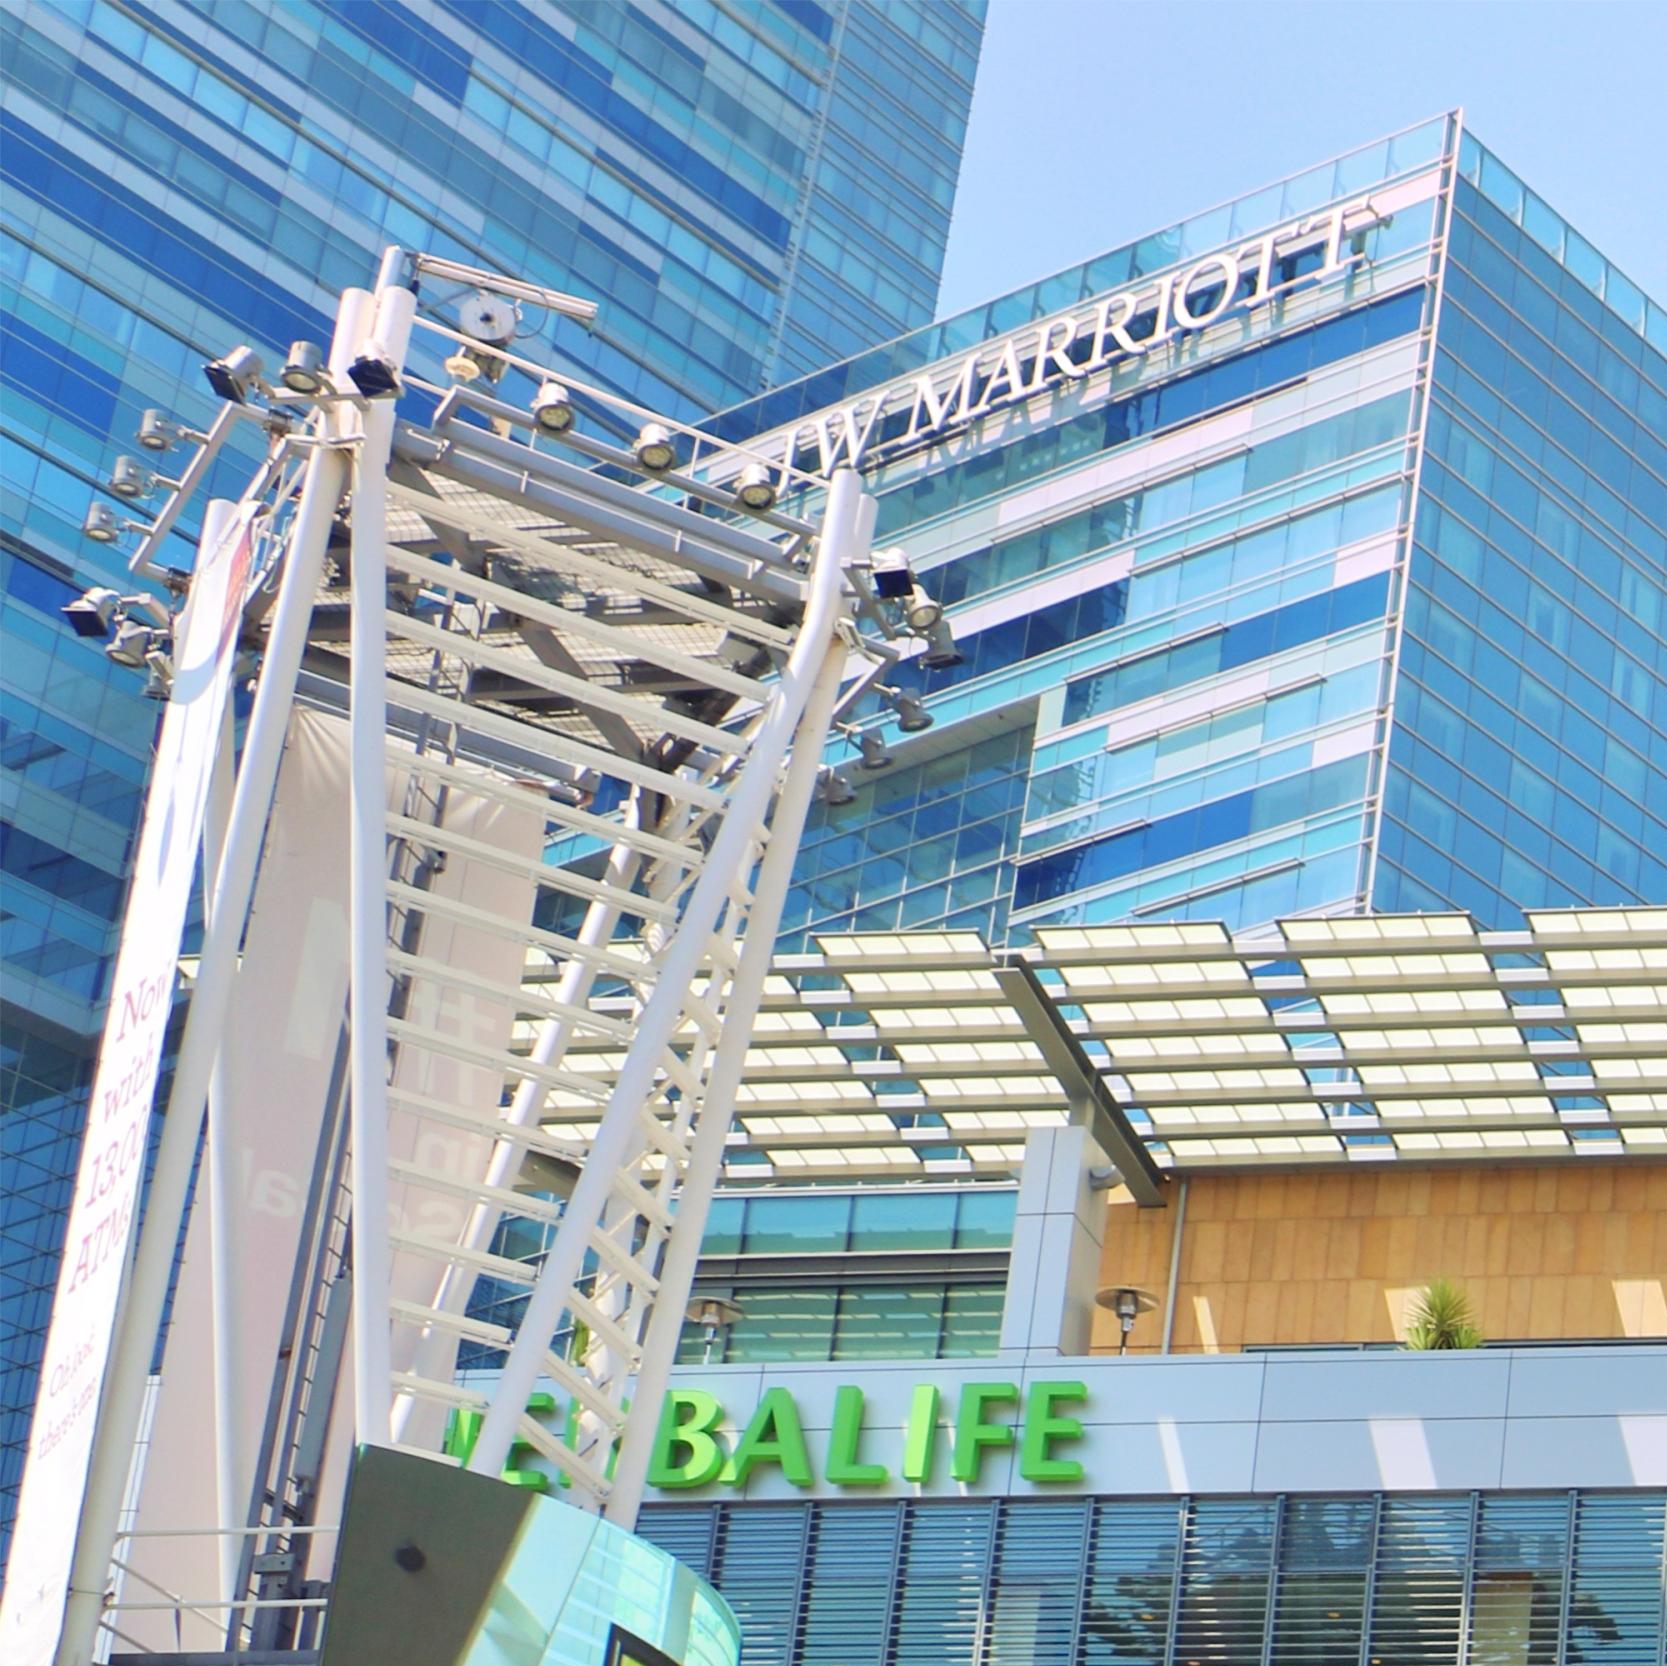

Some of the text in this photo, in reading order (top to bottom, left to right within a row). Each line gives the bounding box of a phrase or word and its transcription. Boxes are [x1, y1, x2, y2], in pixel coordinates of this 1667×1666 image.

[775, 194, 1371, 498] JW MARRIOTT
[444, 1380, 1089, 1492] EBALIFE
